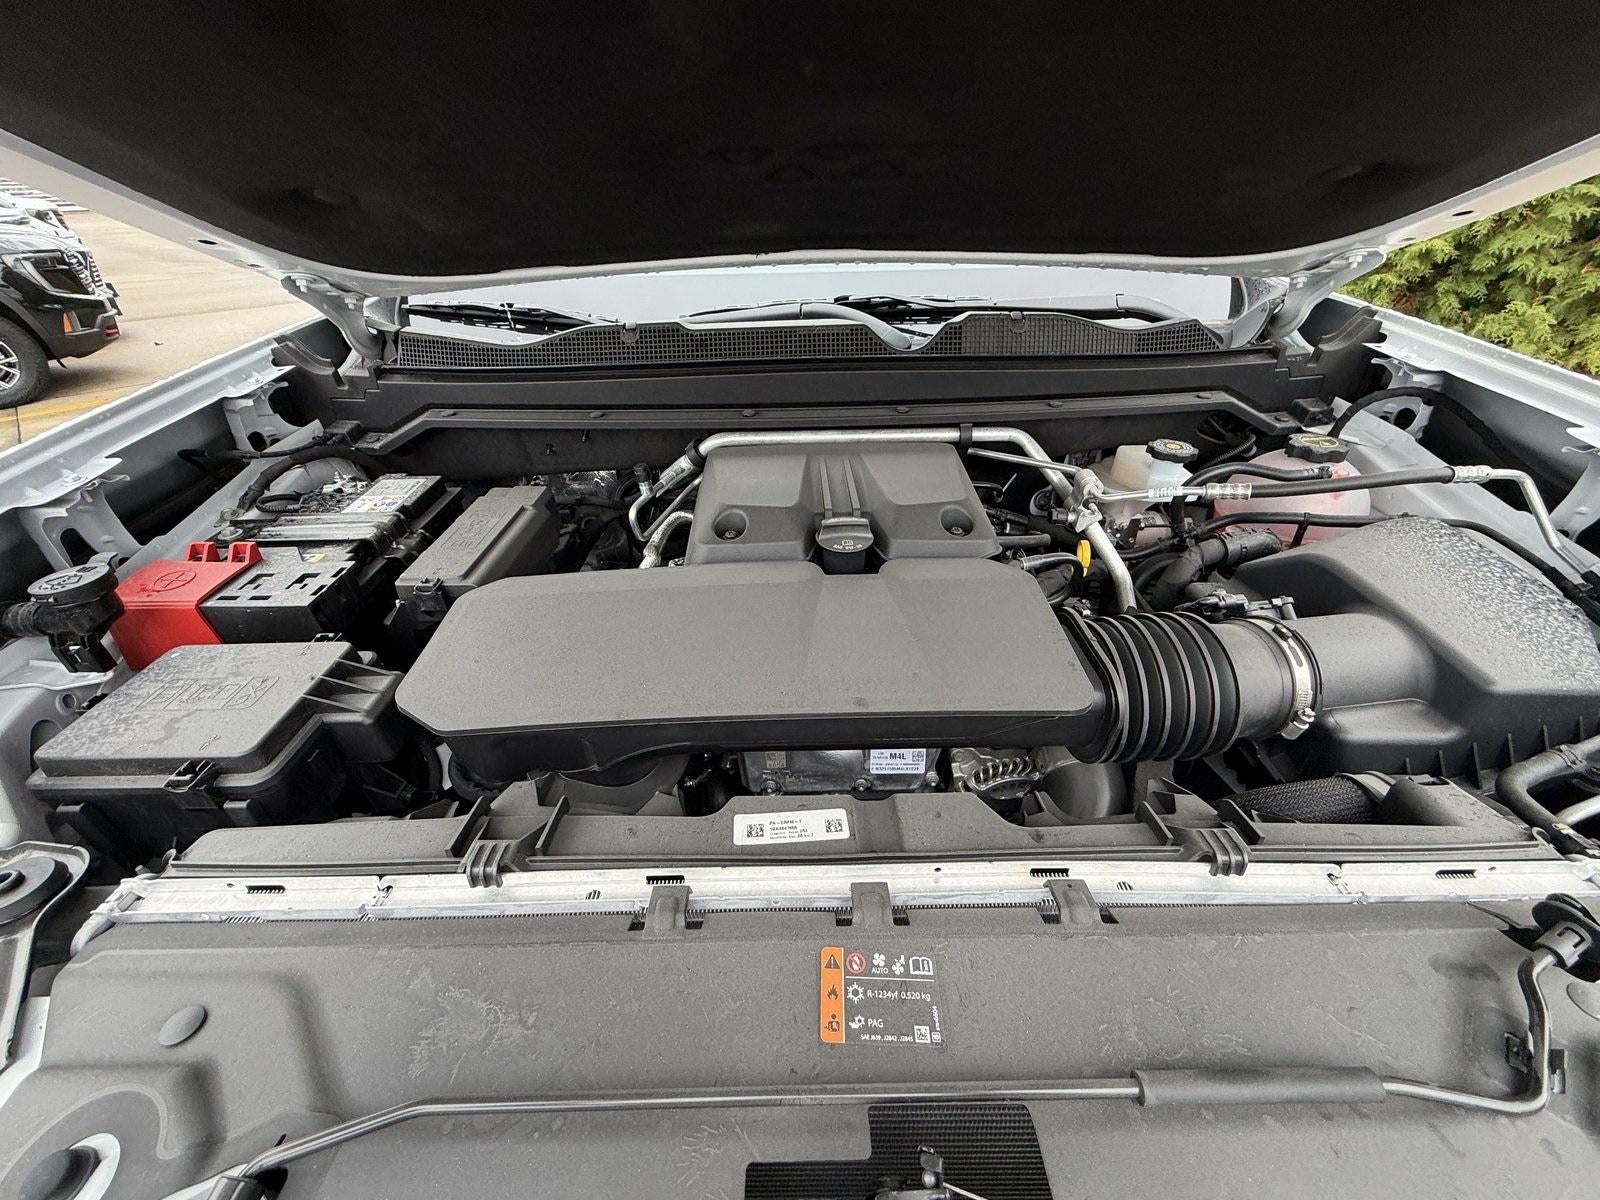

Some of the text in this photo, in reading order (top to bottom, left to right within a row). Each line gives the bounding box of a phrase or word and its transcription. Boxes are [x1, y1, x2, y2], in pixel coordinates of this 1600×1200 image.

[889, 752, 906, 760] M4L
[871, 967, 889, 975] AUTO
[867, 989, 931, 1002] R-1234yf 0.520 kg
[867, 1019, 884, 1028] PAG
